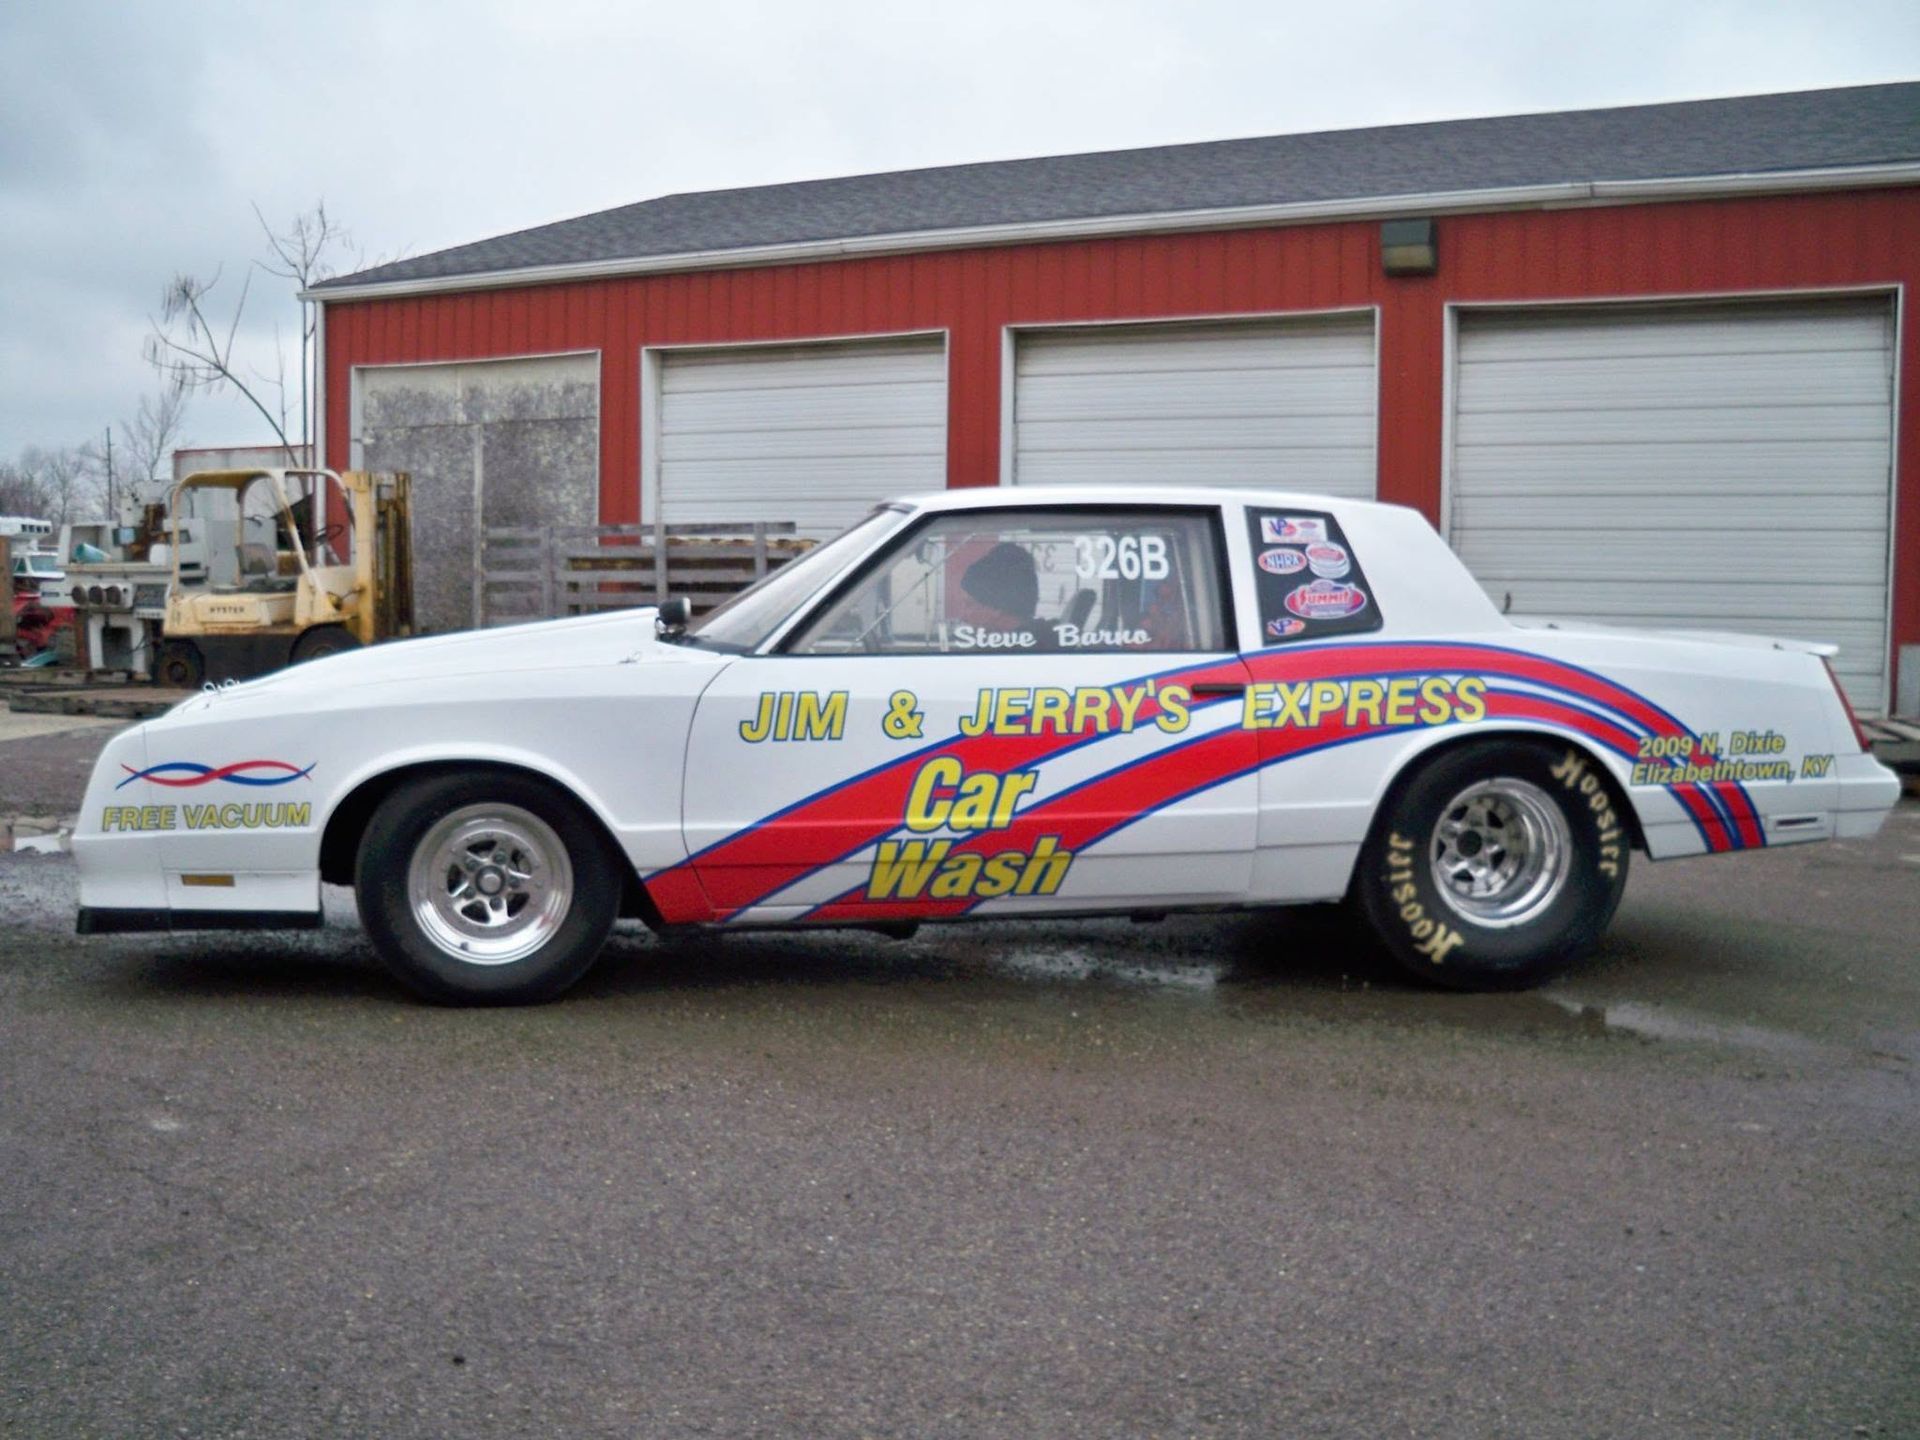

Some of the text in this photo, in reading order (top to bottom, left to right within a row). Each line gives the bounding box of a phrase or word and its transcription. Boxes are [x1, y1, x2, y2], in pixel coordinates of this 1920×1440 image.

[1074, 535, 1169, 580] 326B
[1265, 553, 1300, 569] NHRA
[953, 625, 1037, 648] Steve
[738, 675, 1488, 743] JIM & JERRY'S EXPRESS
[1638, 729, 1787, 759] 2009 N. Dixie
[1630, 754, 1835, 786] Elizabethtown, KY
[904, 754, 1040, 834] Car
[102, 802, 312, 832] FREE VACUUM
[865, 834, 1074, 901] Wash
